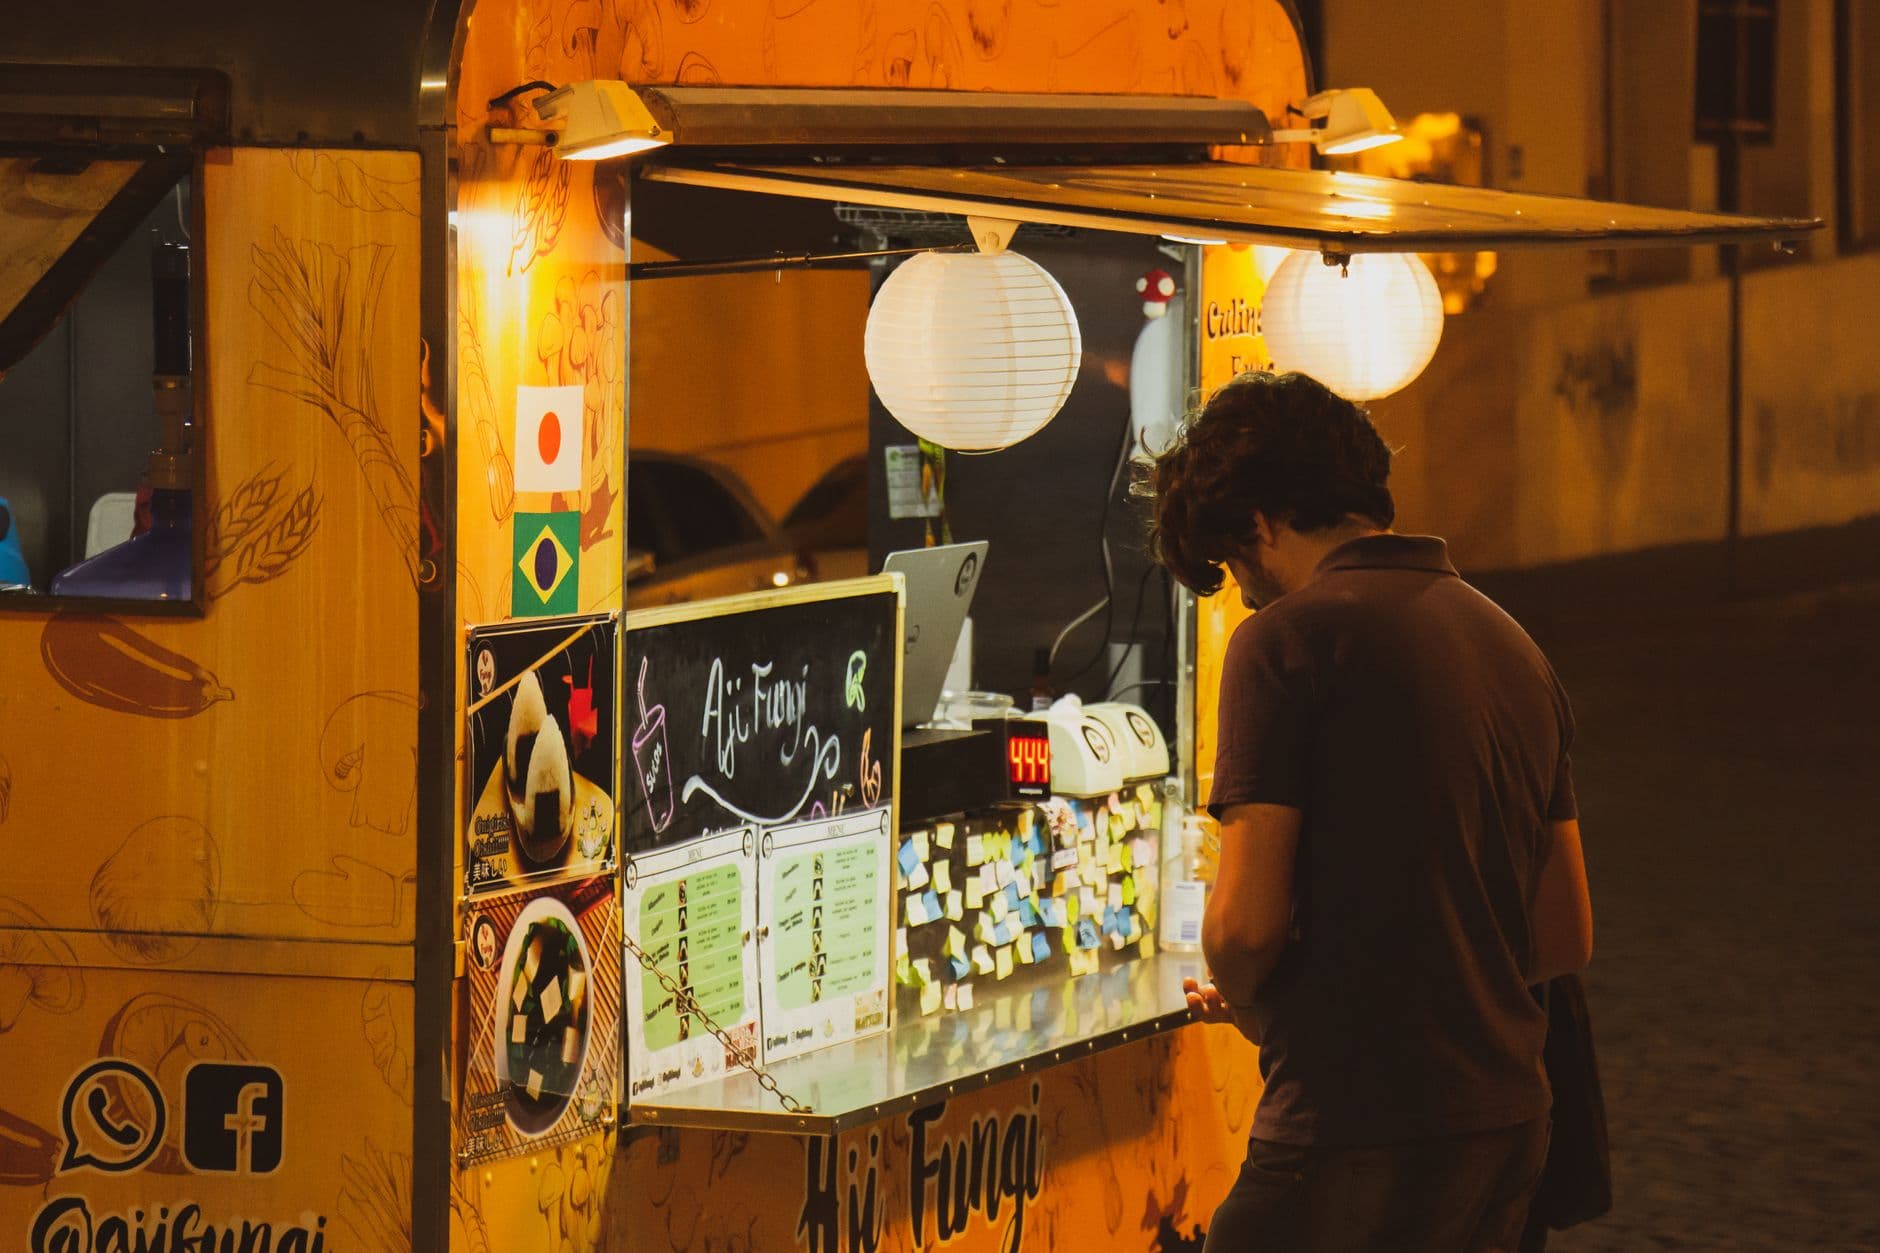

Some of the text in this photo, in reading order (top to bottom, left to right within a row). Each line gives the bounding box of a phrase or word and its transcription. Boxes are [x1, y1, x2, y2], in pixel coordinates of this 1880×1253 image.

[703, 656, 809, 779] Aji Fungi
[907, 1082, 1046, 1253] Fungi
